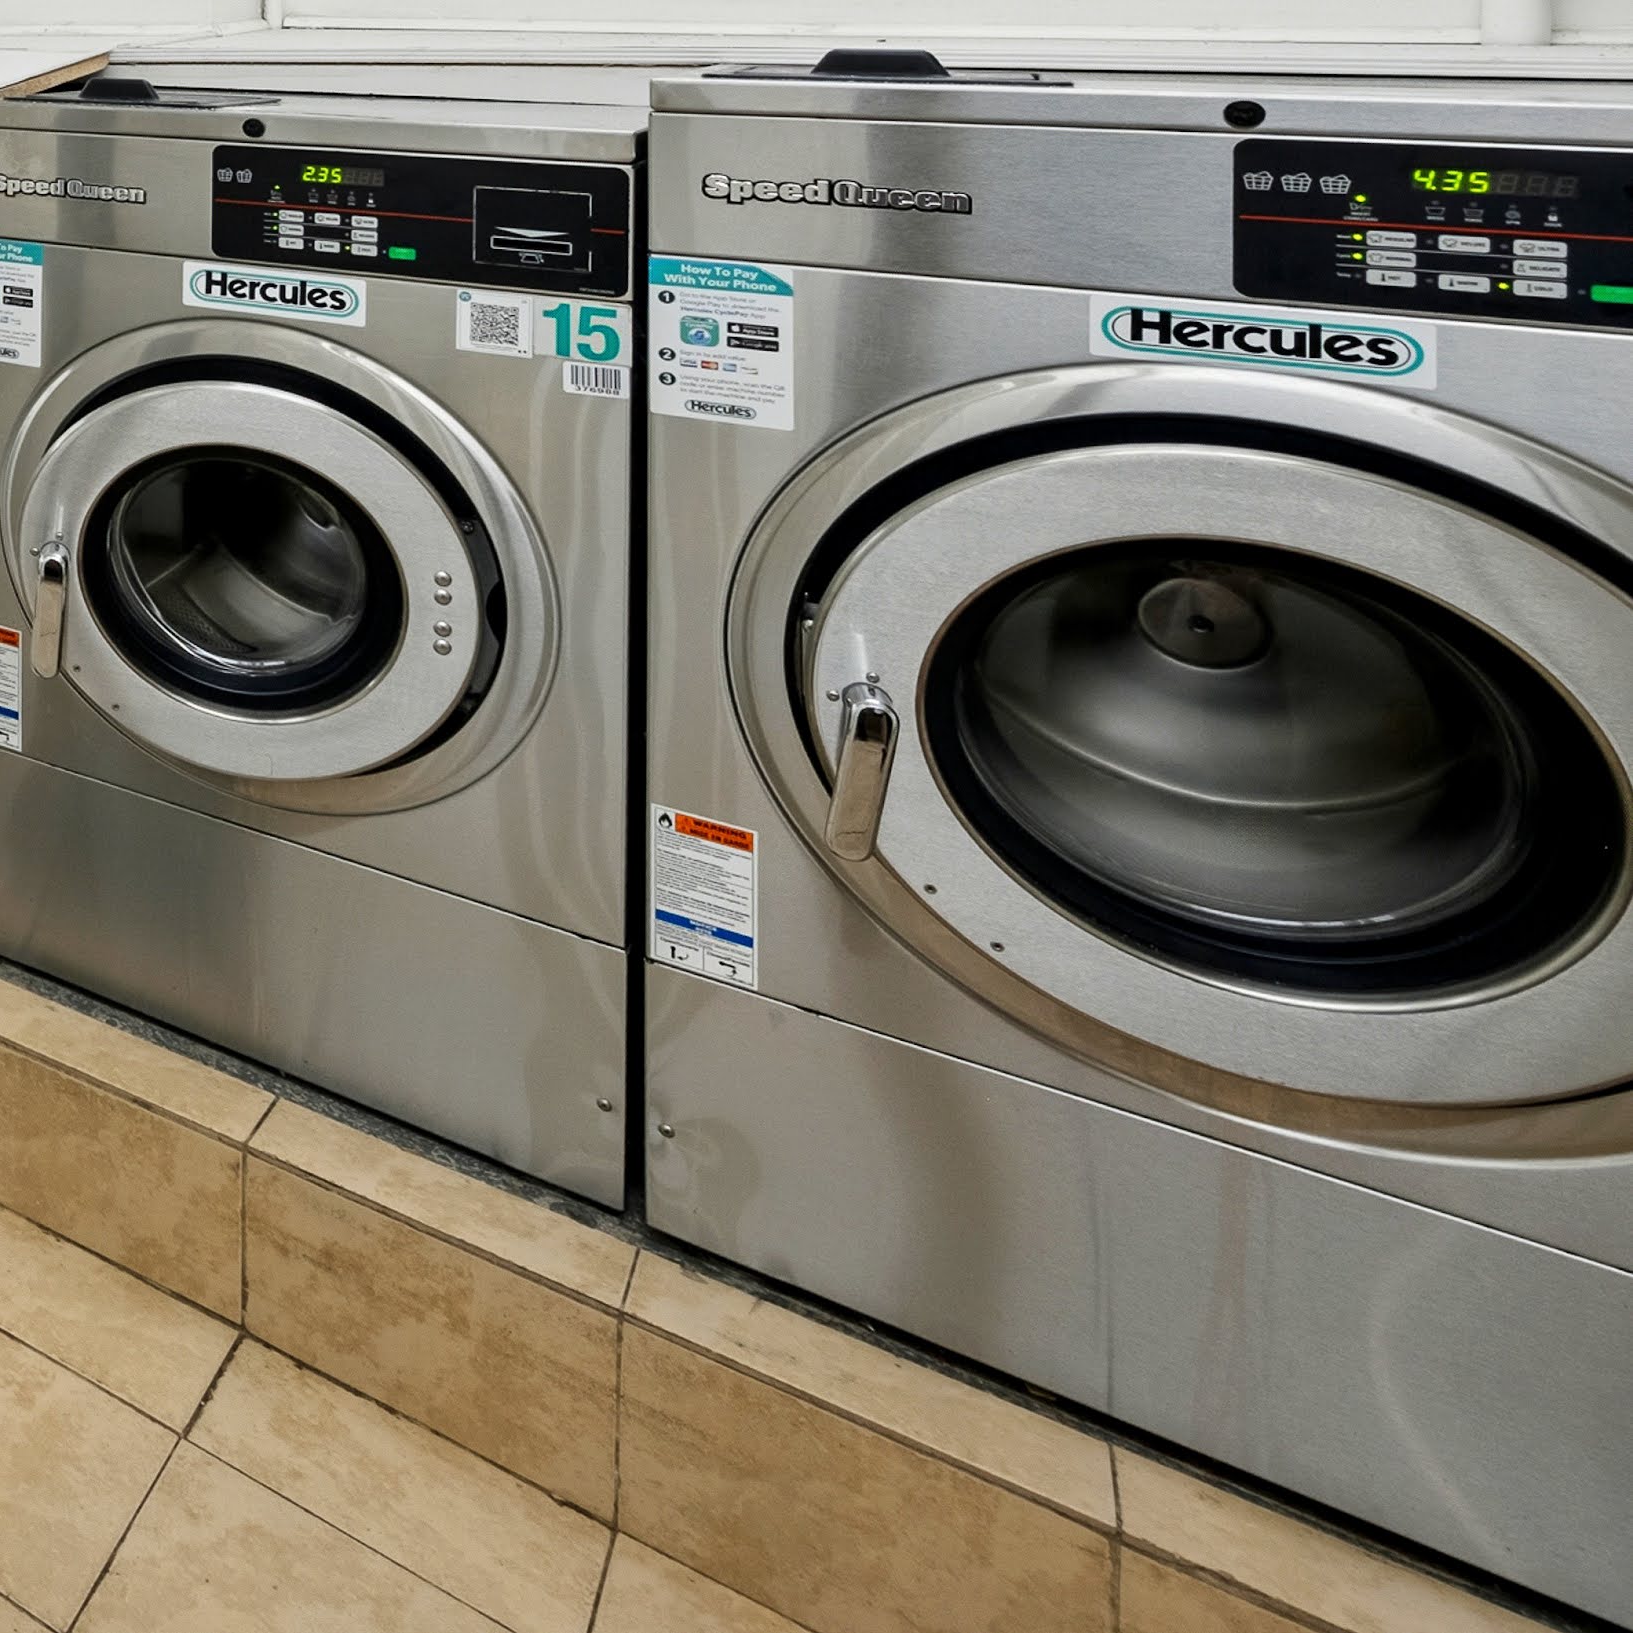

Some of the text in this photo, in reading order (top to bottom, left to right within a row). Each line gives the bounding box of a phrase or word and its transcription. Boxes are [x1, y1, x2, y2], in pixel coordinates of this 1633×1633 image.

[302, 166, 342, 184] 2.35
[1412, 168, 1490, 194] 4.35
[66, 179, 146, 204] Queen
[702, 173, 972, 215] Speed Queen
[7, 253, 33, 263] Phone
[8, 244, 23, 254] Pay
[664, 273, 777, 293] With Your Phone
[680, 264, 758, 281] How To Pay
[205, 269, 347, 313] Hercules
[542, 303, 621, 362] 15
[1130, 308, 1400, 368] Hercules
[690, 400, 752, 418] Hercules
[693, 819, 747, 840] WARNING
